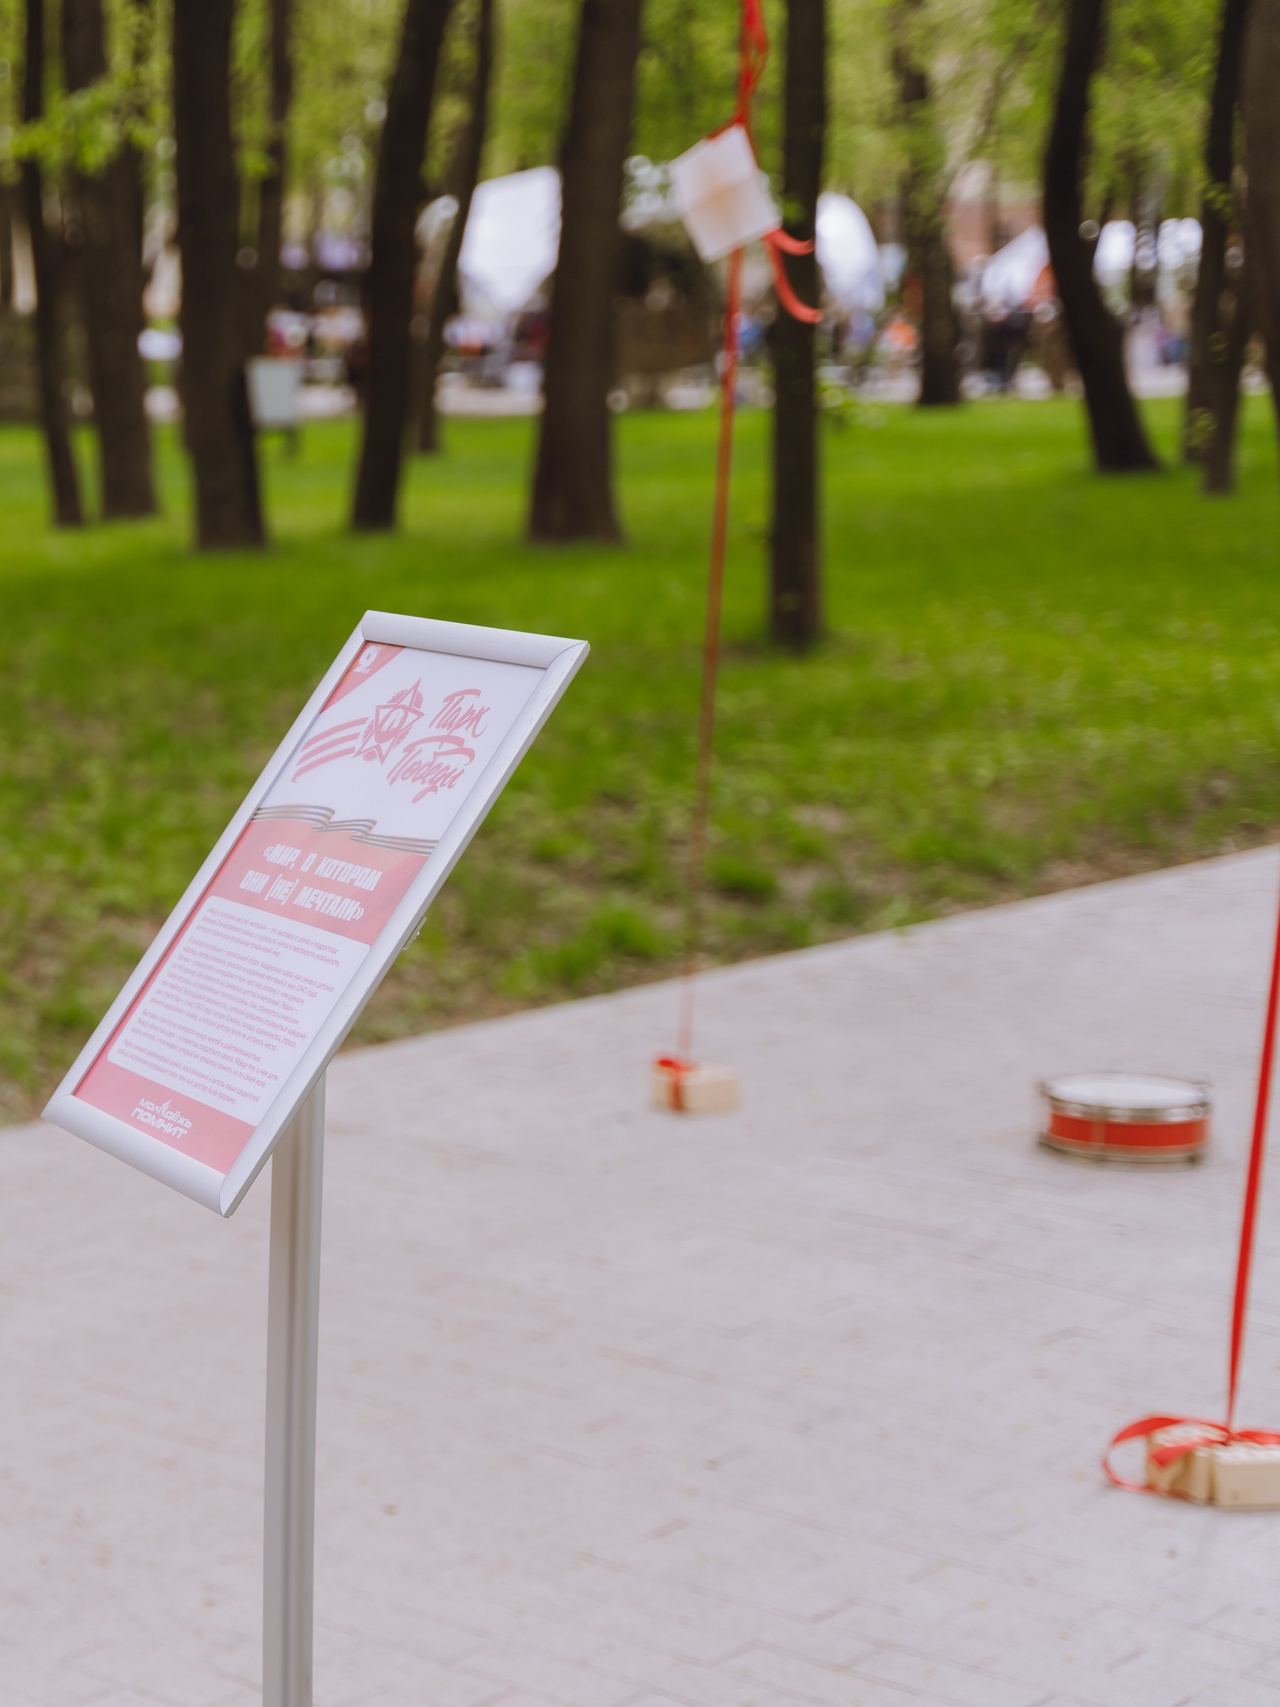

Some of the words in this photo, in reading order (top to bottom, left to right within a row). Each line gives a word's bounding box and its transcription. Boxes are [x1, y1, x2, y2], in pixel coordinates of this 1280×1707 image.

[429, 688, 491, 739] Парк
[386, 734, 475, 804] Победы
[263, 843, 302, 870] «МИР,
[300, 852, 317, 872] О
[314, 856, 383, 892] КОТОРОМ
[239, 869, 271, 894] ОНИ
[264, 873, 300, 906] (НЕ)
[293, 885, 365, 922] МЕЧТАЛИ»
[131, 1107, 188, 1139] ПОМНИТ
